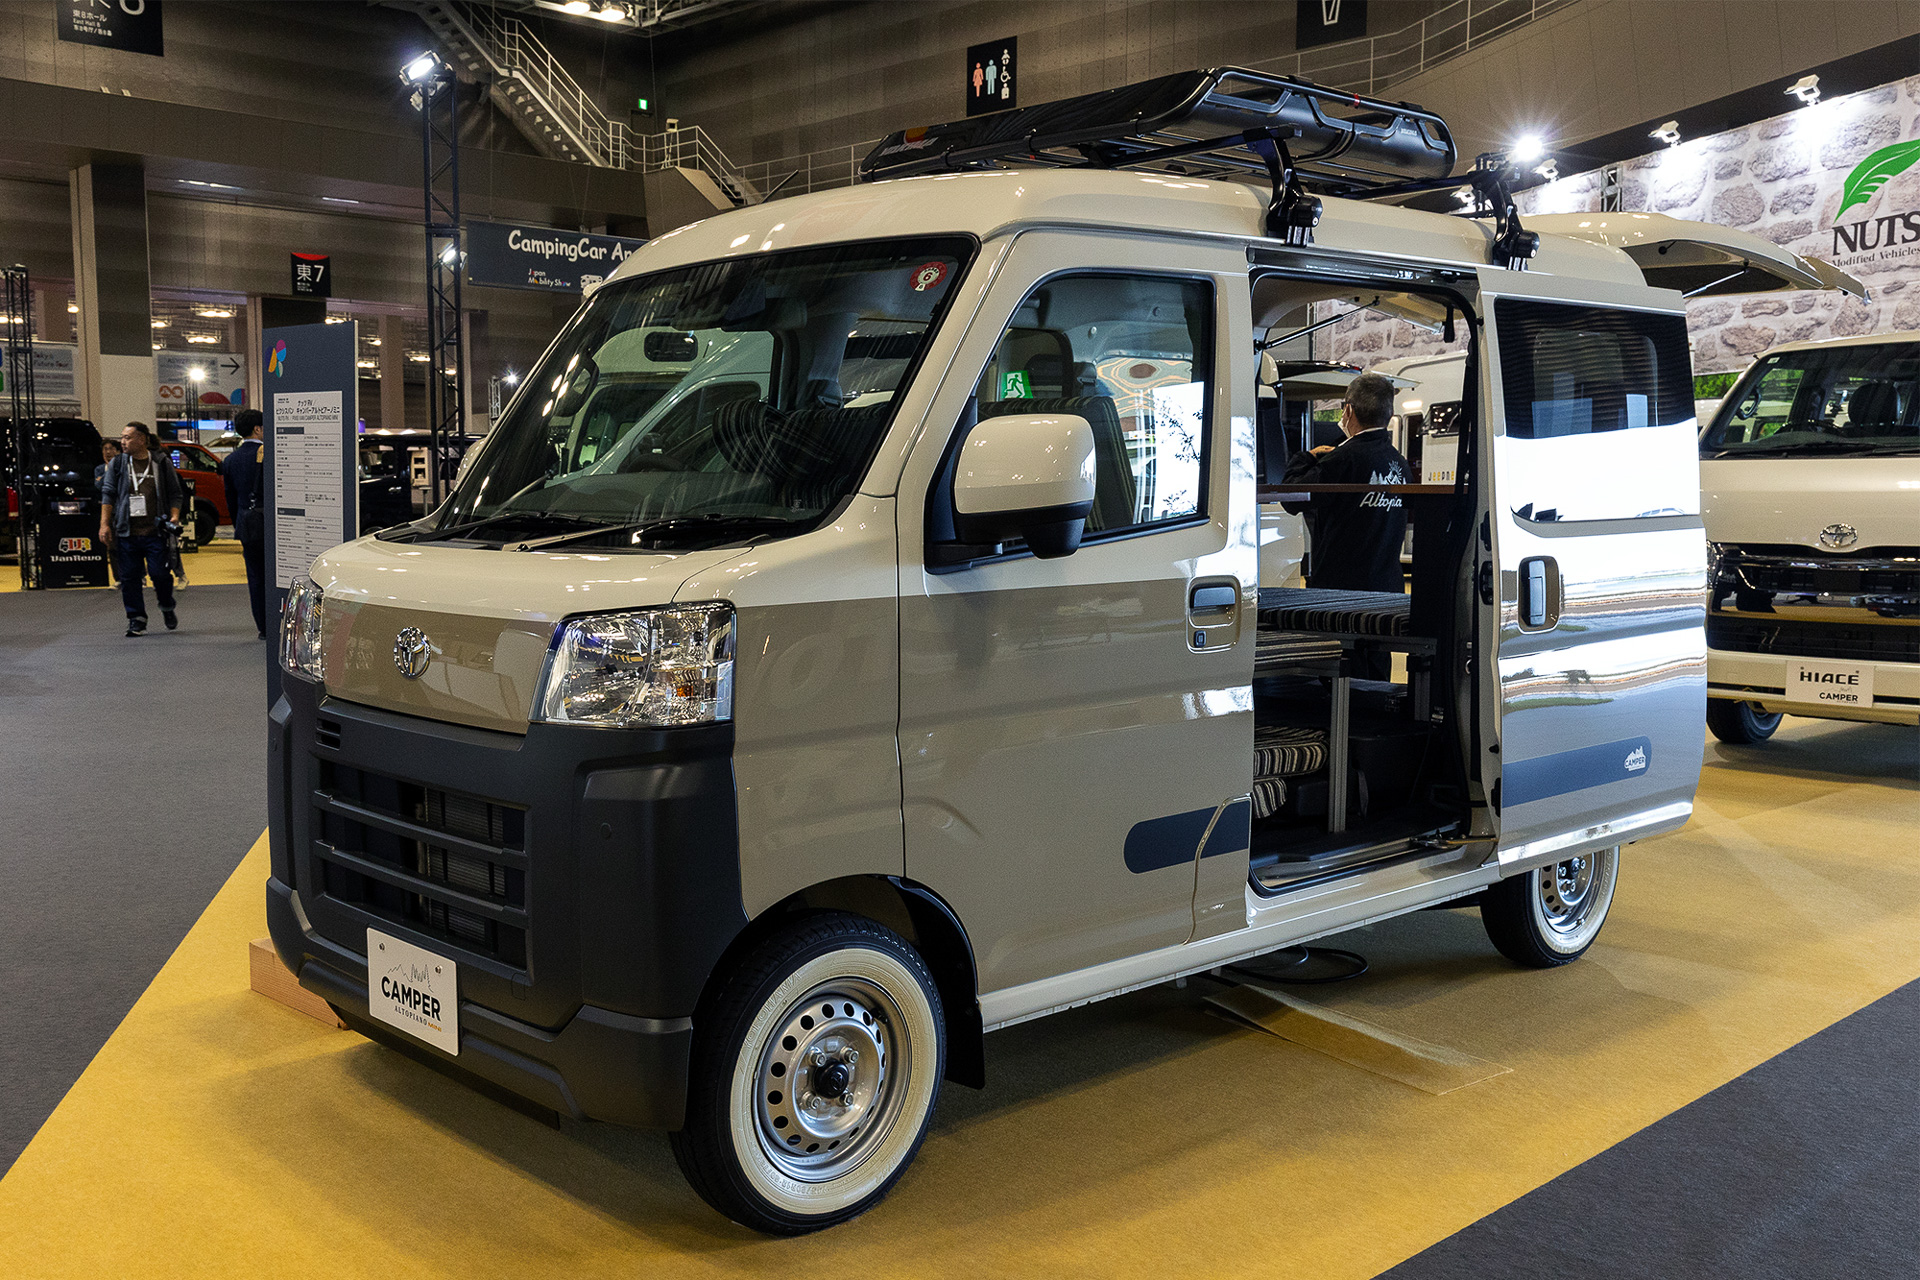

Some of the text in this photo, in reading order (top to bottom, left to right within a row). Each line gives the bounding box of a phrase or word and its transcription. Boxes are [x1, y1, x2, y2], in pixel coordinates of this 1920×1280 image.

[1832, 210, 1920, 256] NUTS
[508, 230, 608, 262] CampingCar
[1800, 671, 1859, 685] HIACE
[1819, 692, 1858, 702] CAMPER
[1624, 756, 1645, 767] CAMPER
[381, 976, 441, 1021] CAMPER
[394, 1005, 427, 1026] ALTOPIANO
